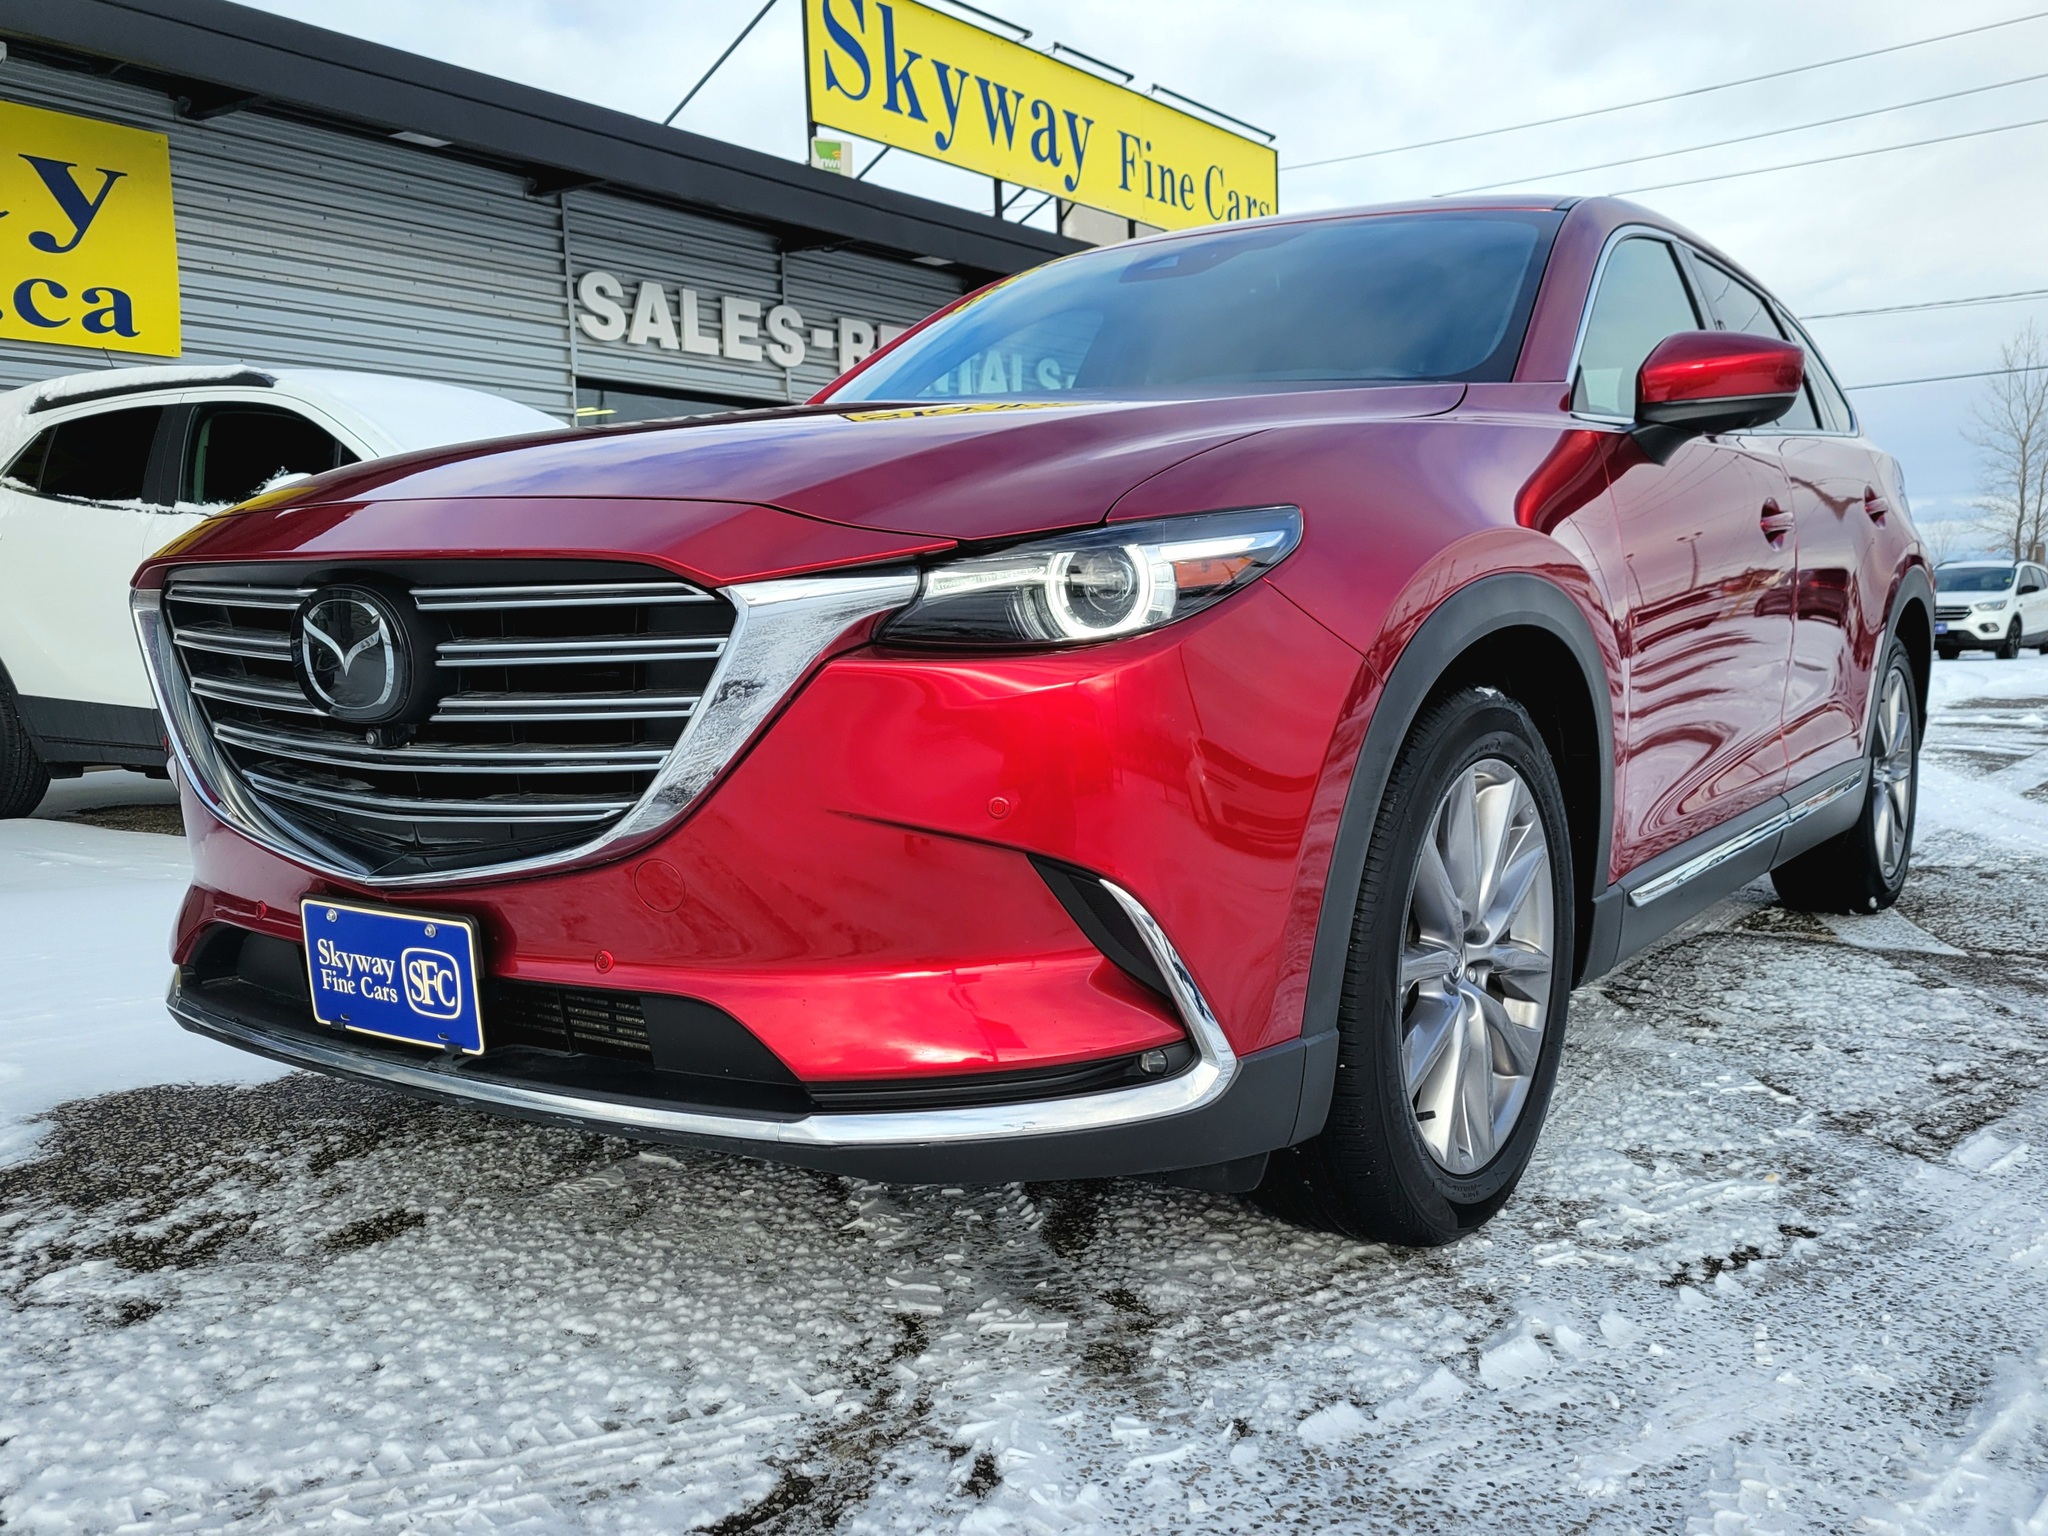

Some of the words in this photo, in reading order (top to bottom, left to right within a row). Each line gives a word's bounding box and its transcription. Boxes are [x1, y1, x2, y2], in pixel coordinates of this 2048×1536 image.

[822, 0, 1095, 192] Skyway
[1117, 130, 1195, 212] Fine
[0, 278, 141, 338] ca
[317, 938, 395, 984] Skyway
[408, 959, 455, 1007] SFC
[320, 968, 356, 995] Fine
[360, 976, 398, 1003] Cars
